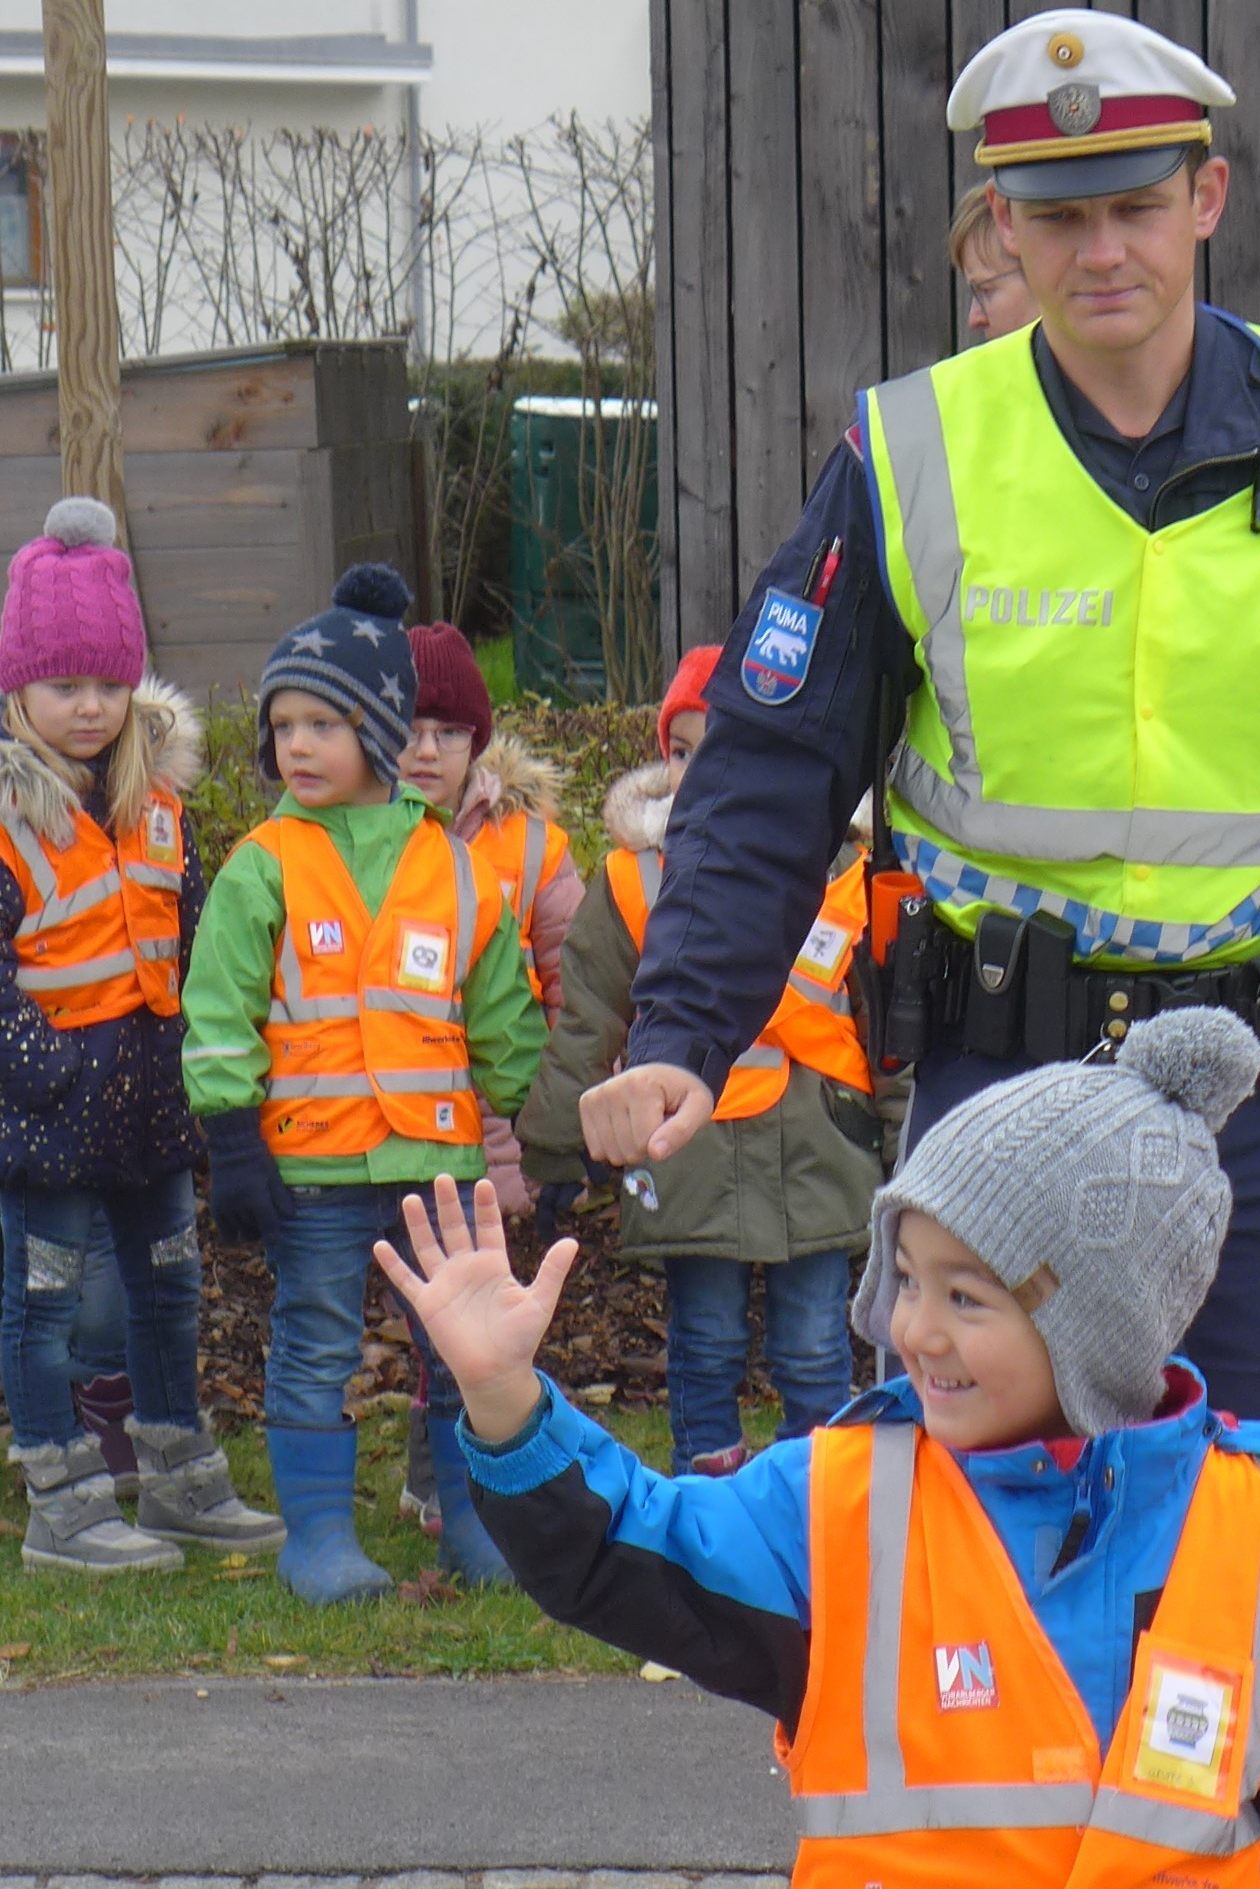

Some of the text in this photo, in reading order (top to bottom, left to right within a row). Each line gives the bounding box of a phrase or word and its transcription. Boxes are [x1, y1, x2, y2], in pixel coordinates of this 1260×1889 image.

[768, 601, 808, 635] PUMA
[966, 584, 1113, 627] POLIZEI
[309, 921, 341, 946] VN
[936, 1642, 993, 1693] VN
